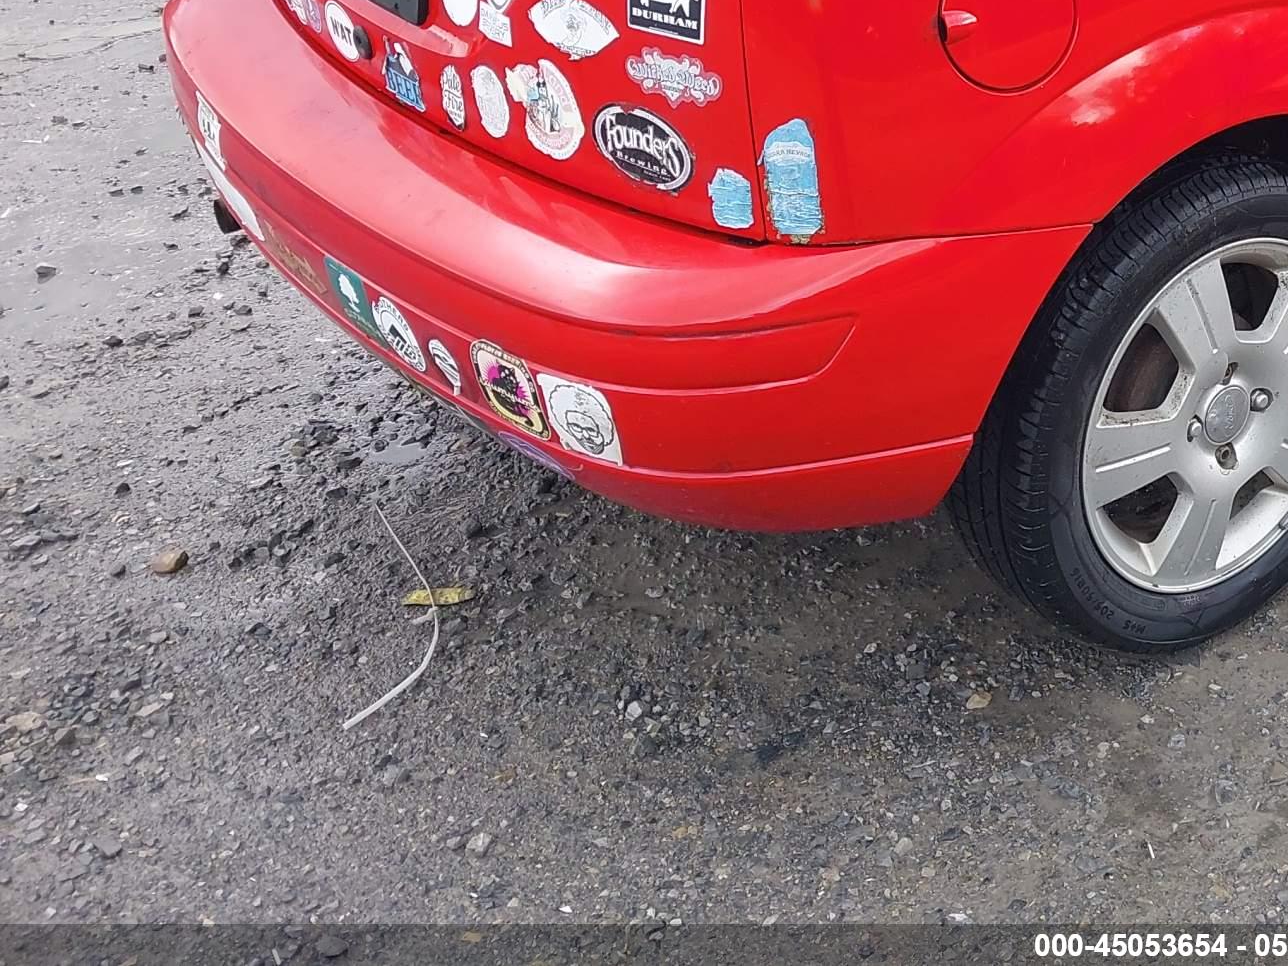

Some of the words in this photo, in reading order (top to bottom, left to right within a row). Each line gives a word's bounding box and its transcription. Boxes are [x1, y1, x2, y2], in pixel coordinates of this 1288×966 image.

[631, 6, 699, 31] DURHAM
[442, 72, 460, 92] Pale
[444, 93, 463, 113] Fire
